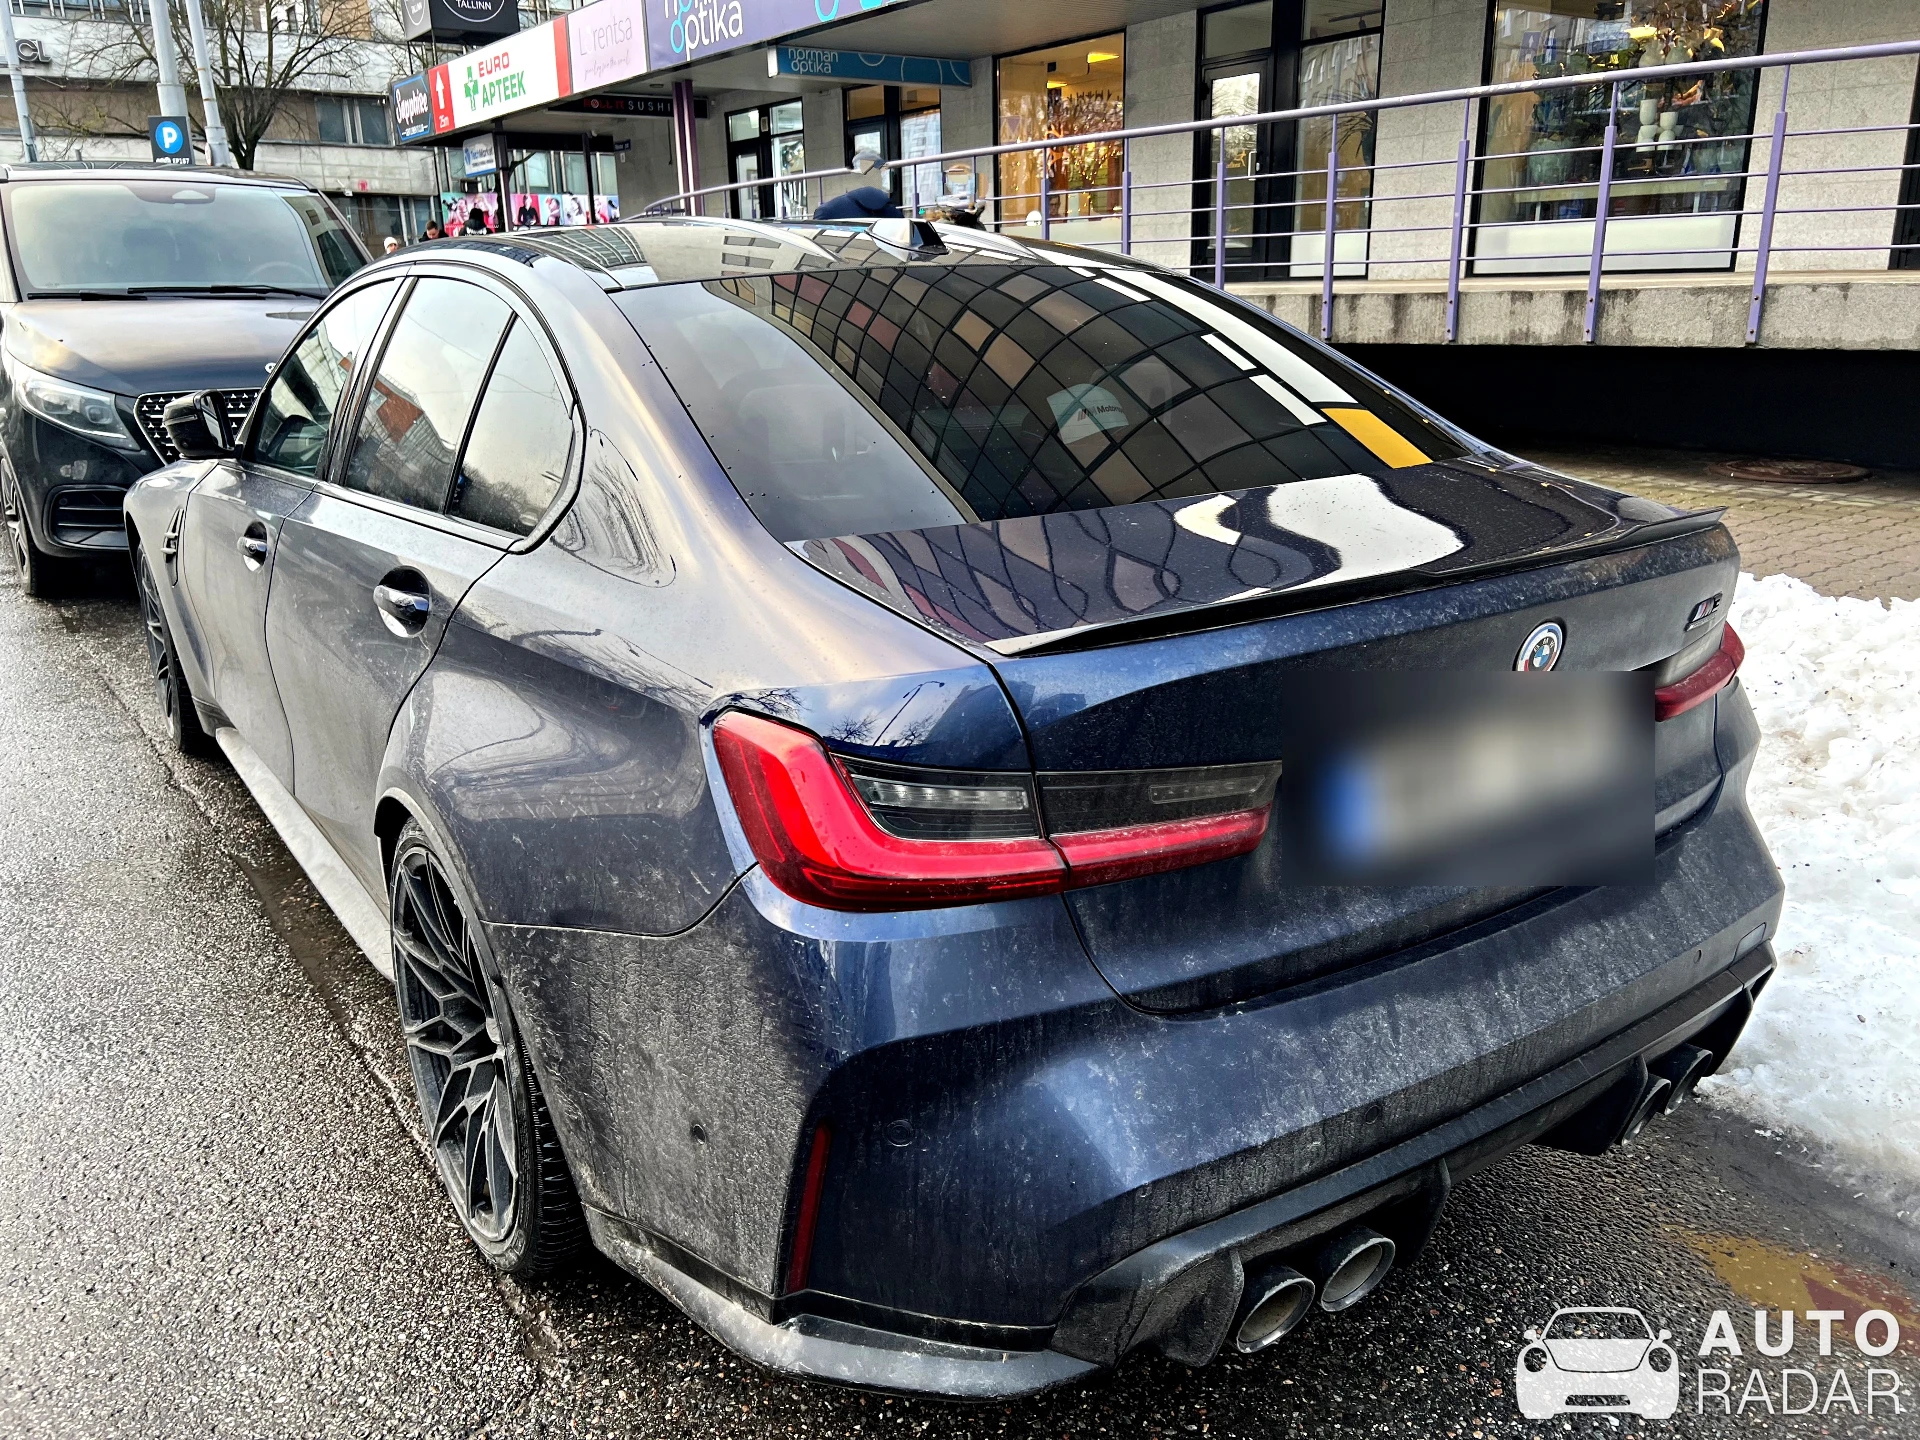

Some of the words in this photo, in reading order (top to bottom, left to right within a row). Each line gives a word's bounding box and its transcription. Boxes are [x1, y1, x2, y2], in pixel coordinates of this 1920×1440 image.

[456, 0, 492, 11] TALLINN
[670, 0, 744, 61] optika
[788, 48, 839, 63] norman
[478, 52, 510, 78] EURO
[790, 58, 832, 74] optika
[482, 70, 527, 108] APTEEK
[628, 100, 671, 112] SUSHI
